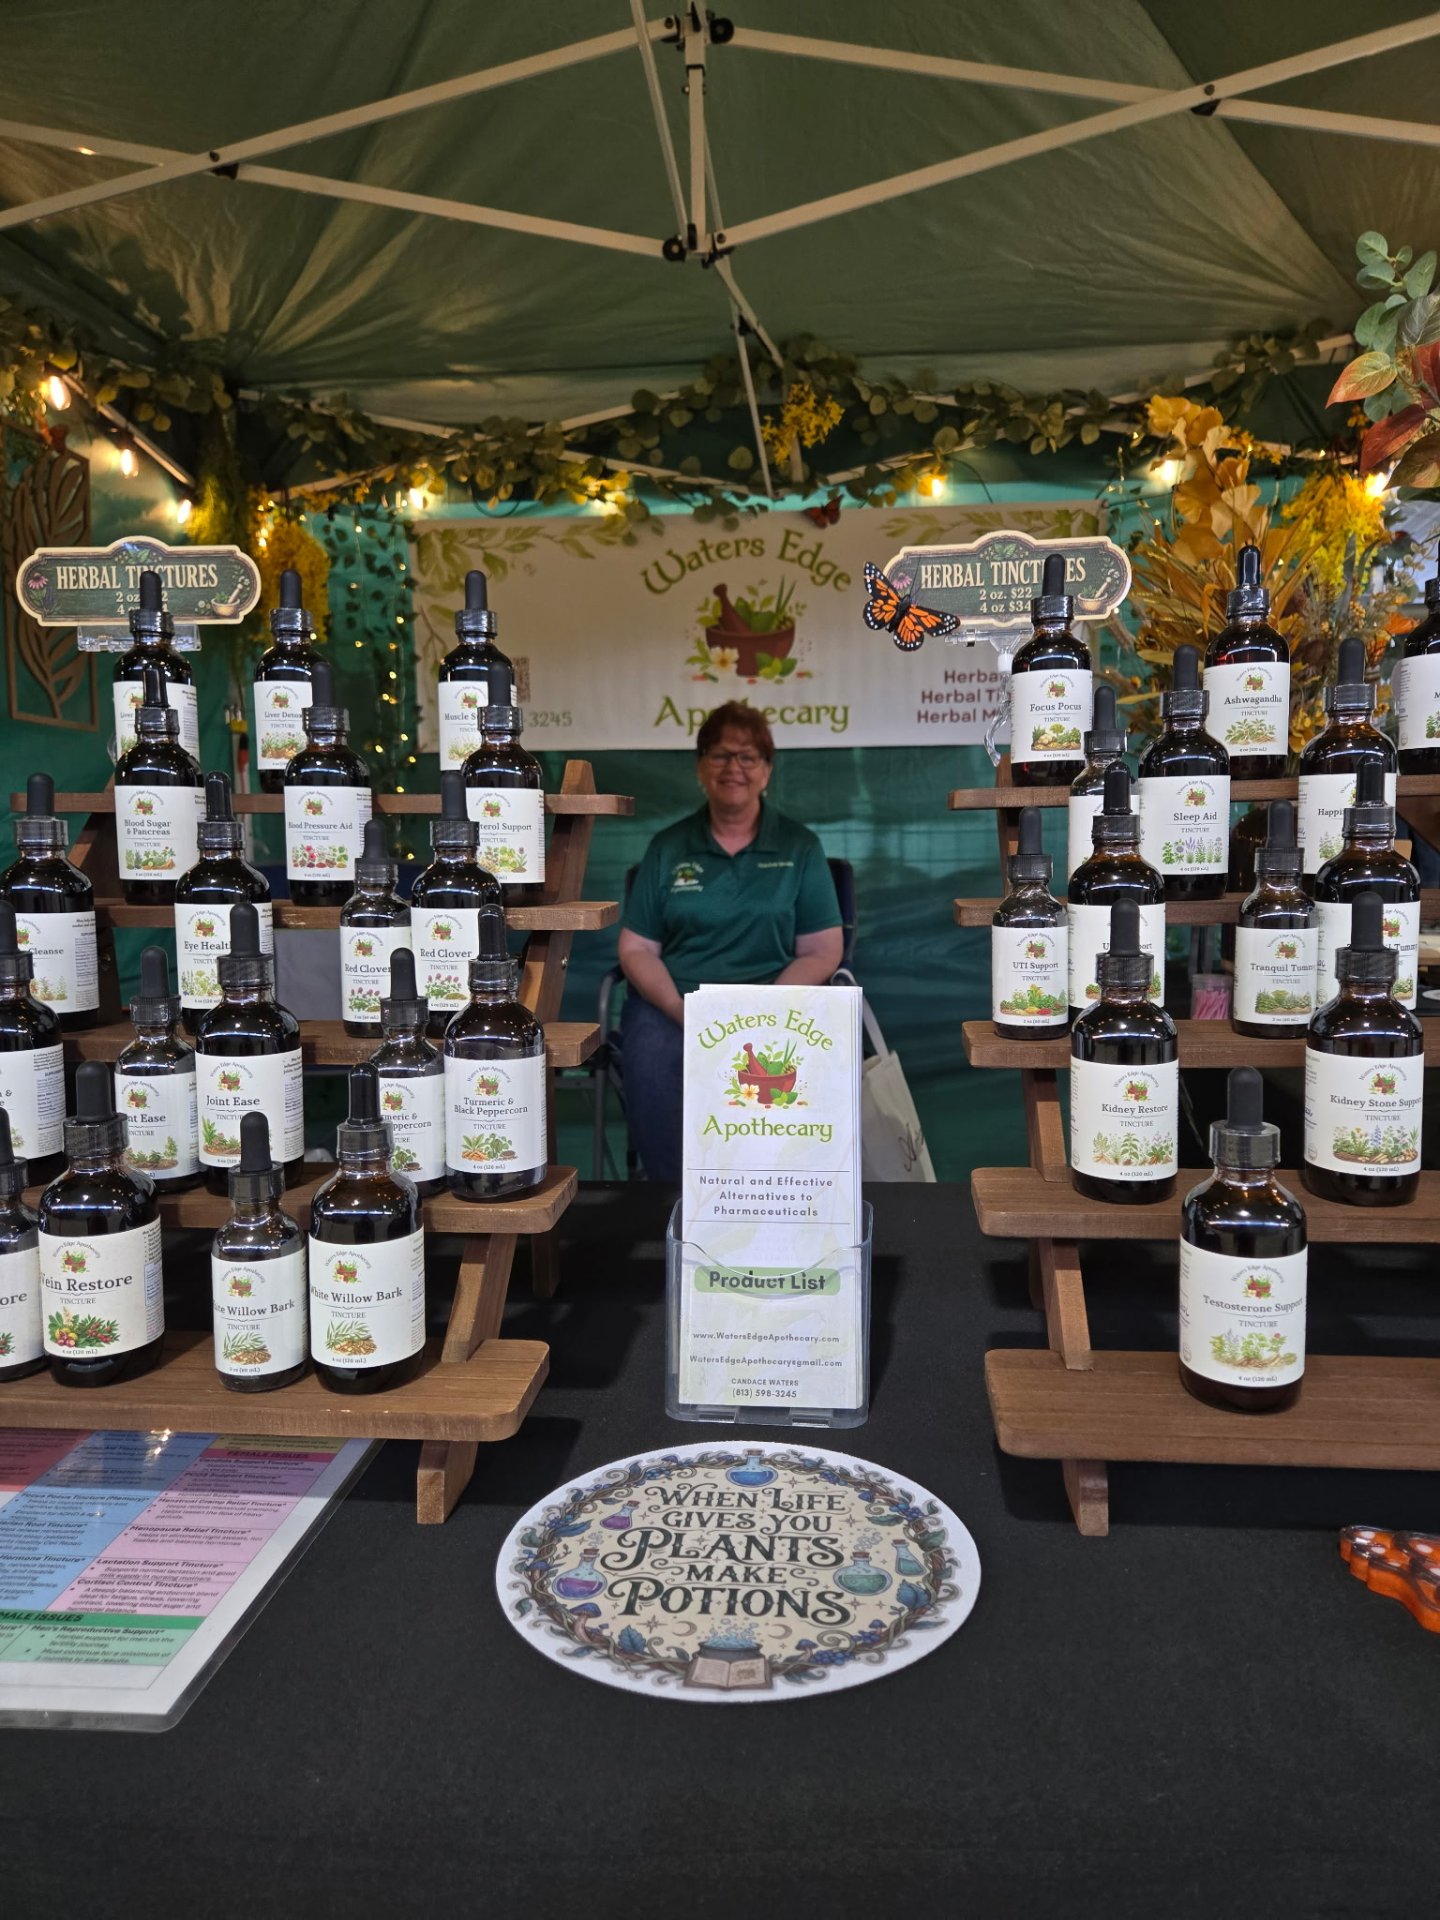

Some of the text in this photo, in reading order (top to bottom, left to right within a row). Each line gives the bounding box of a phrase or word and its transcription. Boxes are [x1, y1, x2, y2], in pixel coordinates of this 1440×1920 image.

[641, 528, 852, 594] Waters Edge
[56, 566, 122, 590] HERBAL
[921, 557, 1086, 590] HERBAL TINCTES
[116, 592, 123, 602] 2
[979, 590, 987, 600] 2
[1011, 587, 1032, 598] $22
[980, 604, 988, 613] 4
[944, 671, 999, 684] Herba
[921, 690, 981, 704] Herbal
[1224, 694, 1282, 704] Ashwagandha
[1030, 704, 1056, 712] Focus
[917, 709, 976, 723] Herbal
[1174, 812, 1217, 822] Sleep Aid
[124, 820, 171, 829] Blood Sugar
[502, 823, 532, 832] Support
[184, 941, 231, 952] Eye Healt
[420, 948, 473, 958] Red Clover
[345, 964, 358, 973] Red
[1030, 962, 1058, 971] Support
[1250, 963, 1288, 973] Tranquil
[698, 1009, 833, 1050] Waters Edge
[206, 1095, 260, 1106] Joint Ease
[464, 1097, 506, 1106] Turmeric
[1330, 1094, 1366, 1108] Kidney
[1368, 1099, 1397, 1108] Stone
[454, 1105, 528, 1117] Black Peppercorn
[1102, 1104, 1168, 1116] Kidney Restore
[140, 1114, 166, 1123] Ease
[702, 1115, 833, 1142] Apothecary
[700, 1176, 833, 1187] Natural and Effective
[720, 1192, 812, 1201] Alternatives to
[714, 1206, 818, 1216] Pharmaceuticals
[66, 1275, 132, 1292] Restore
[710, 1271, 826, 1290] Product List
[60, 1297, 96, 1305] TINCTURE
[332, 1292, 372, 1304] Willow
[376, 1287, 403, 1302] Bark
[227, 1306, 266, 1316] Willow
[270, 1300, 295, 1313] Bark
[1203, 1294, 1272, 1312] Testosterone
[693, 1332, 840, 1343] www.WatersEdgeApothecary.com
[731, 1378, 799, 1386] CANDACE WATERS
[732, 1388, 797, 1398] (813) 598-3245
[645, 1483, 846, 1512] WHEN LIFE
[662, 1510, 832, 1536] GIVES YOU
[600, 1526, 845, 1571] PLANTS
[142, 1560, 179, 1568] Support
[686, 1564, 788, 1584] MAKE
[607, 1576, 852, 1627] POTIONS
[33, 1614, 84, 1622] ISSUES
[60, 1626, 120, 1634] Reproductive
